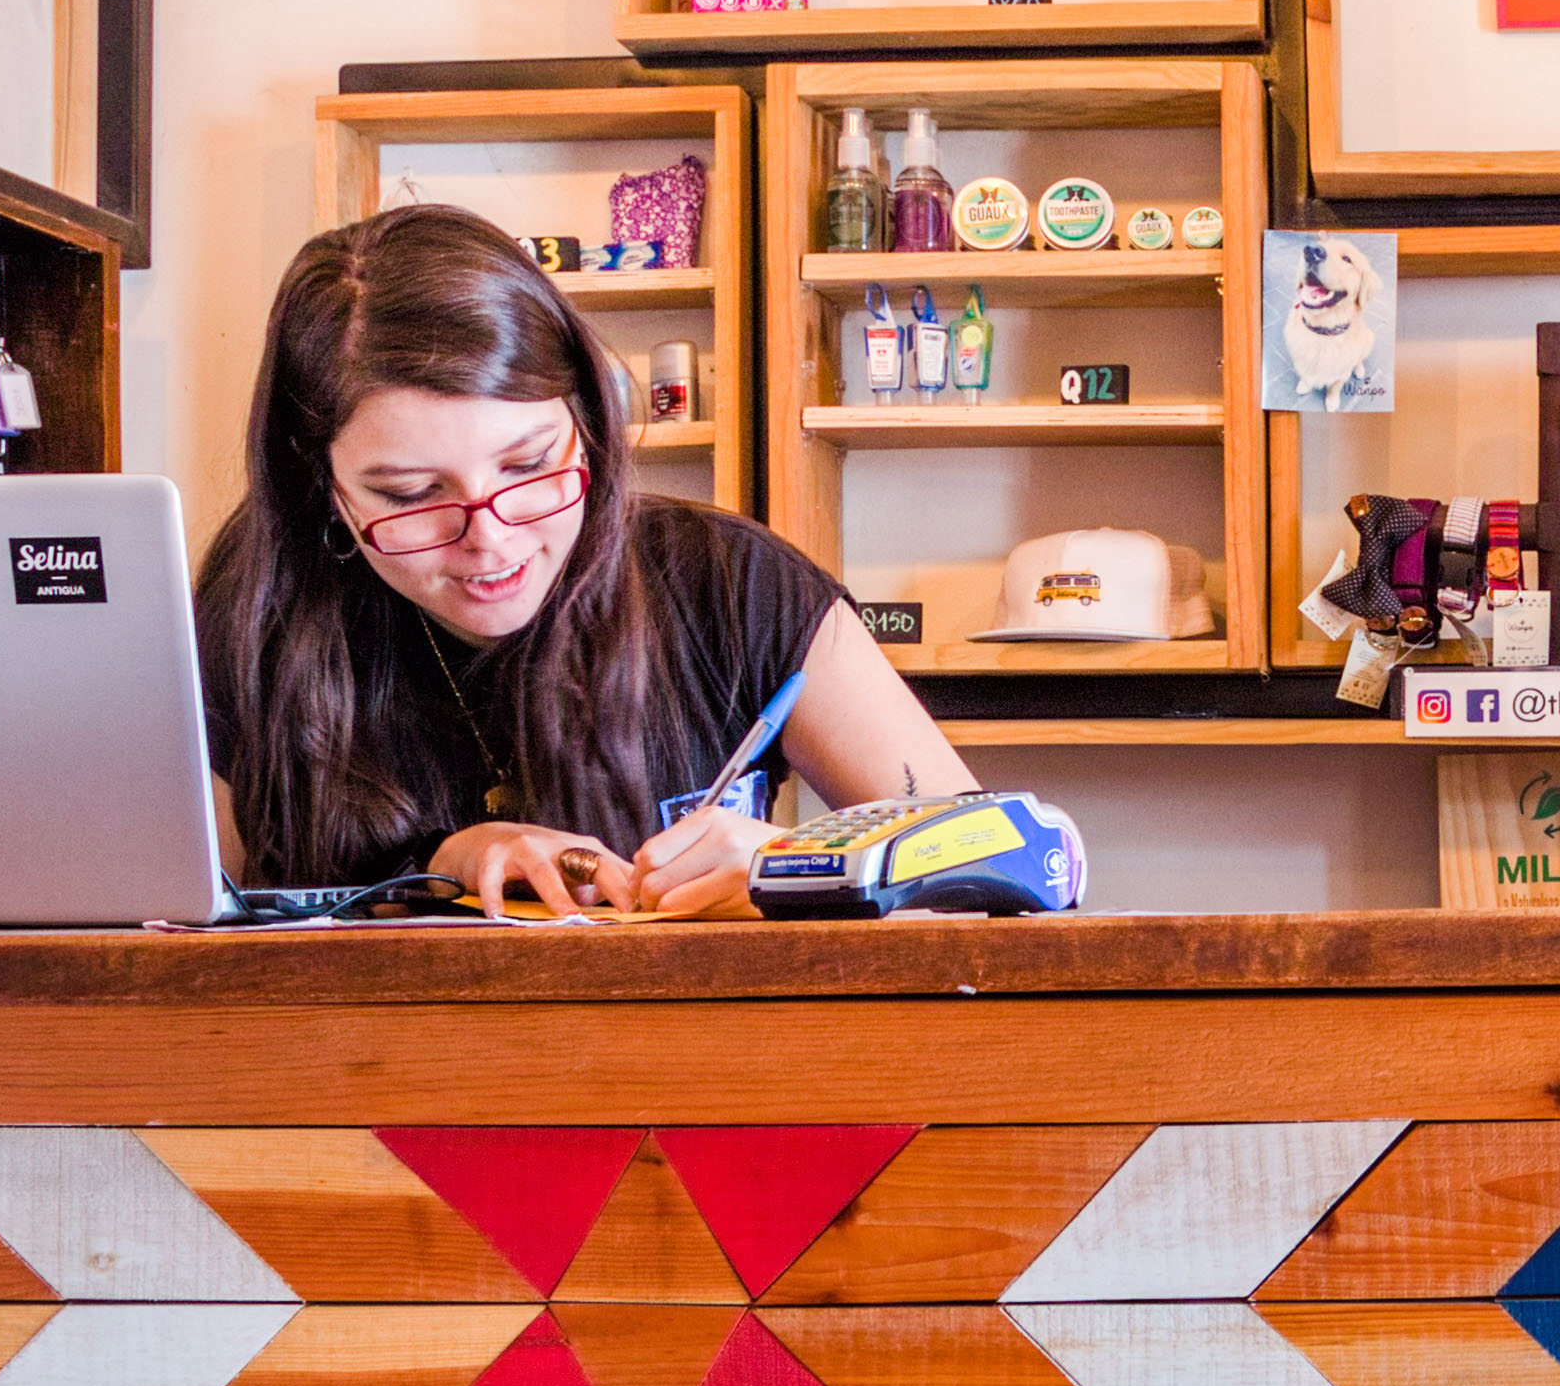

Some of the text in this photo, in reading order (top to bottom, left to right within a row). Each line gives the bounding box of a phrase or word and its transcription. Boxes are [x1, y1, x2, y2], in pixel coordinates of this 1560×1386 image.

[968, 204, 1011, 222] GUAUX
[1048, 205, 1100, 217] TOOTHPASTE
[1060, 366, 1114, 404] Q12
[17, 544, 99, 572] Selina
[36, 585, 86, 596] ANTIGUA
